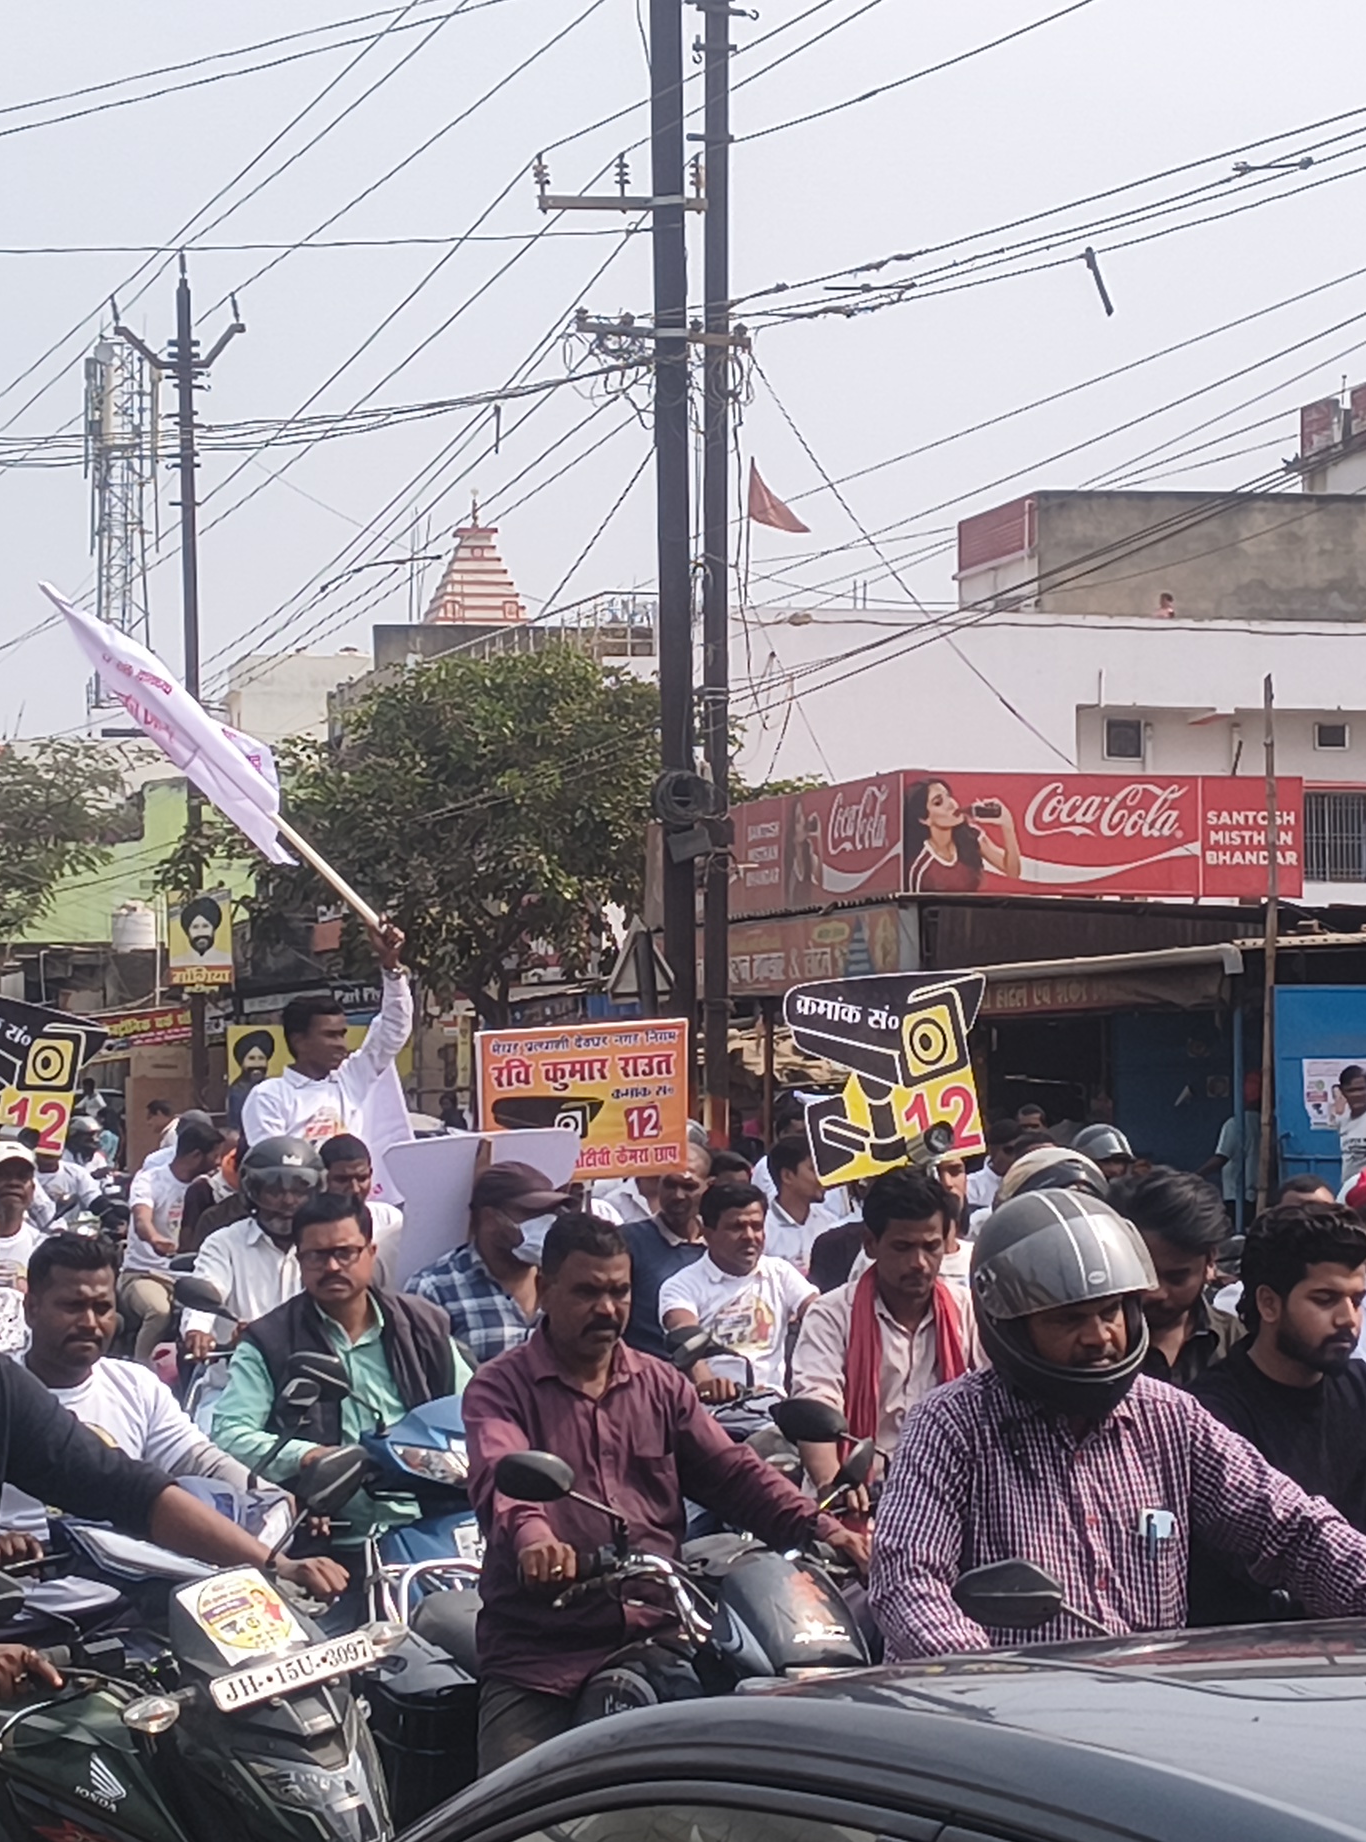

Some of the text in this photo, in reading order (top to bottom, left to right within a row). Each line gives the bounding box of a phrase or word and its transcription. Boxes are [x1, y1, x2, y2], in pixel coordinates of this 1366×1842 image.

[1024, 782, 1189, 838] Coca-Cola
[1210, 830, 1293, 846] MISTHN
[796, 995, 863, 1024] क्रमांक
[491, 1052, 674, 1091] रवि कुमार राउत
[7, 1097, 67, 1150] 12
[628, 1107, 658, 1138] 12
[903, 1086, 982, 1150] 12
